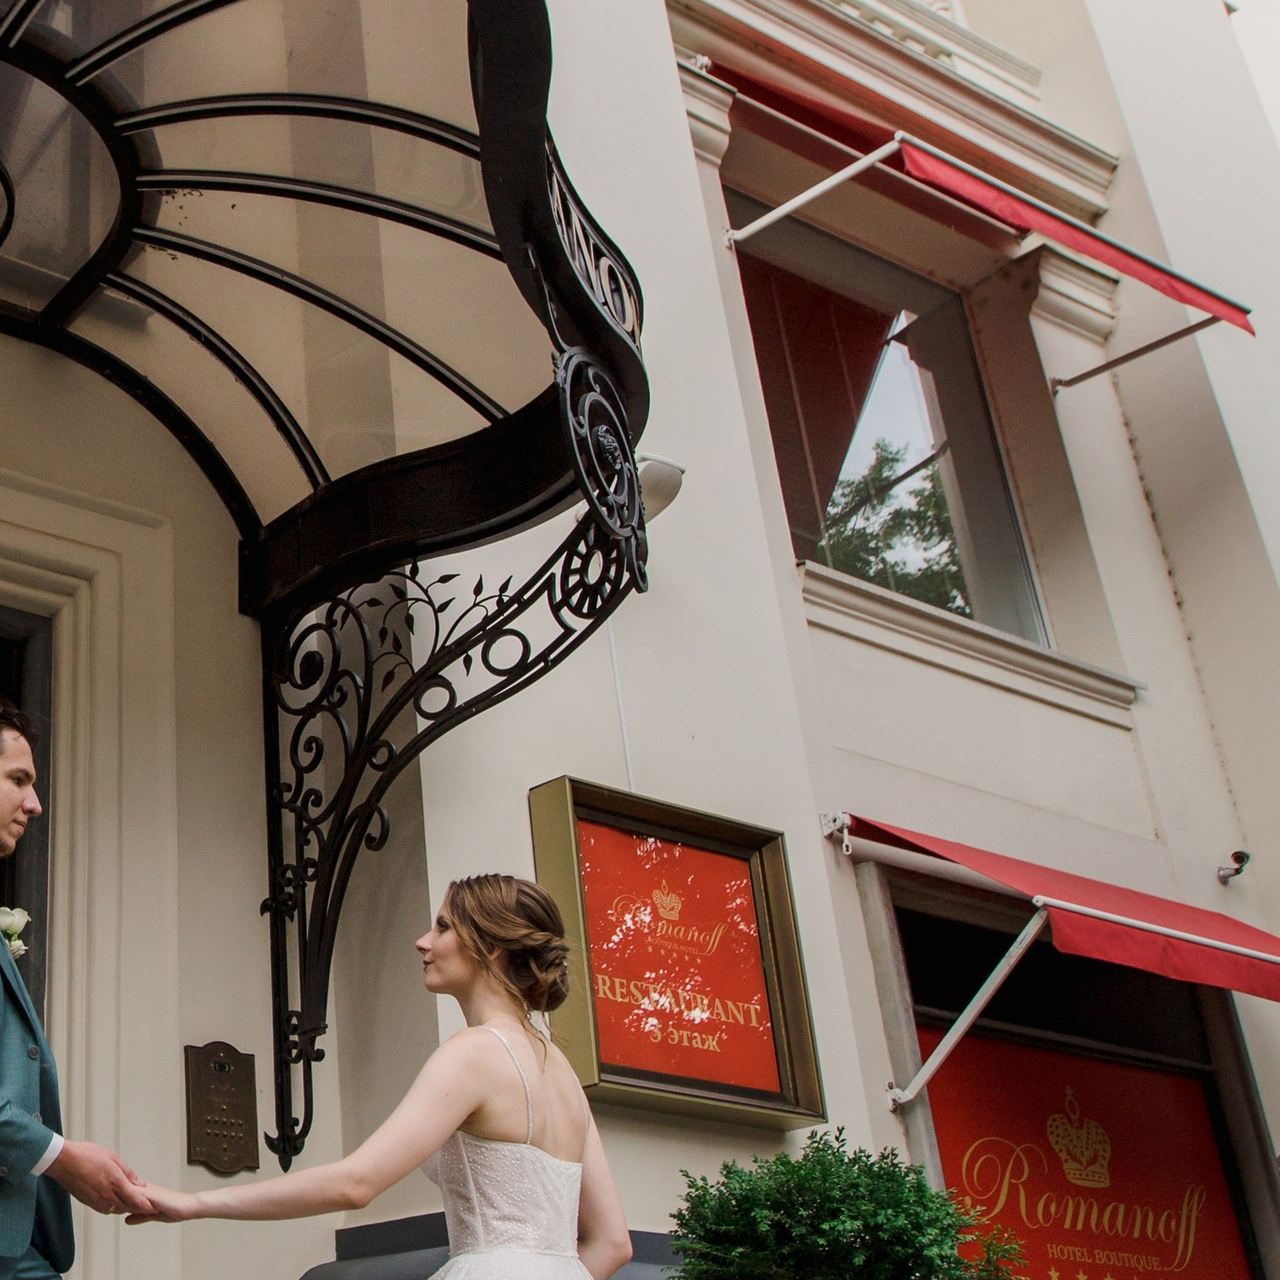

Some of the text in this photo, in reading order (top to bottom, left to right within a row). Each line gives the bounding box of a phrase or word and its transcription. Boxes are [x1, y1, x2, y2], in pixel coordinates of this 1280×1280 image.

[596, 973, 761, 1028] RESTAURANT
[668, 1027, 721, 1052] этаж
[961, 1136, 1206, 1272] Romanoff
[1046, 1243, 1162, 1272] HOTEL BOUTIQUE
